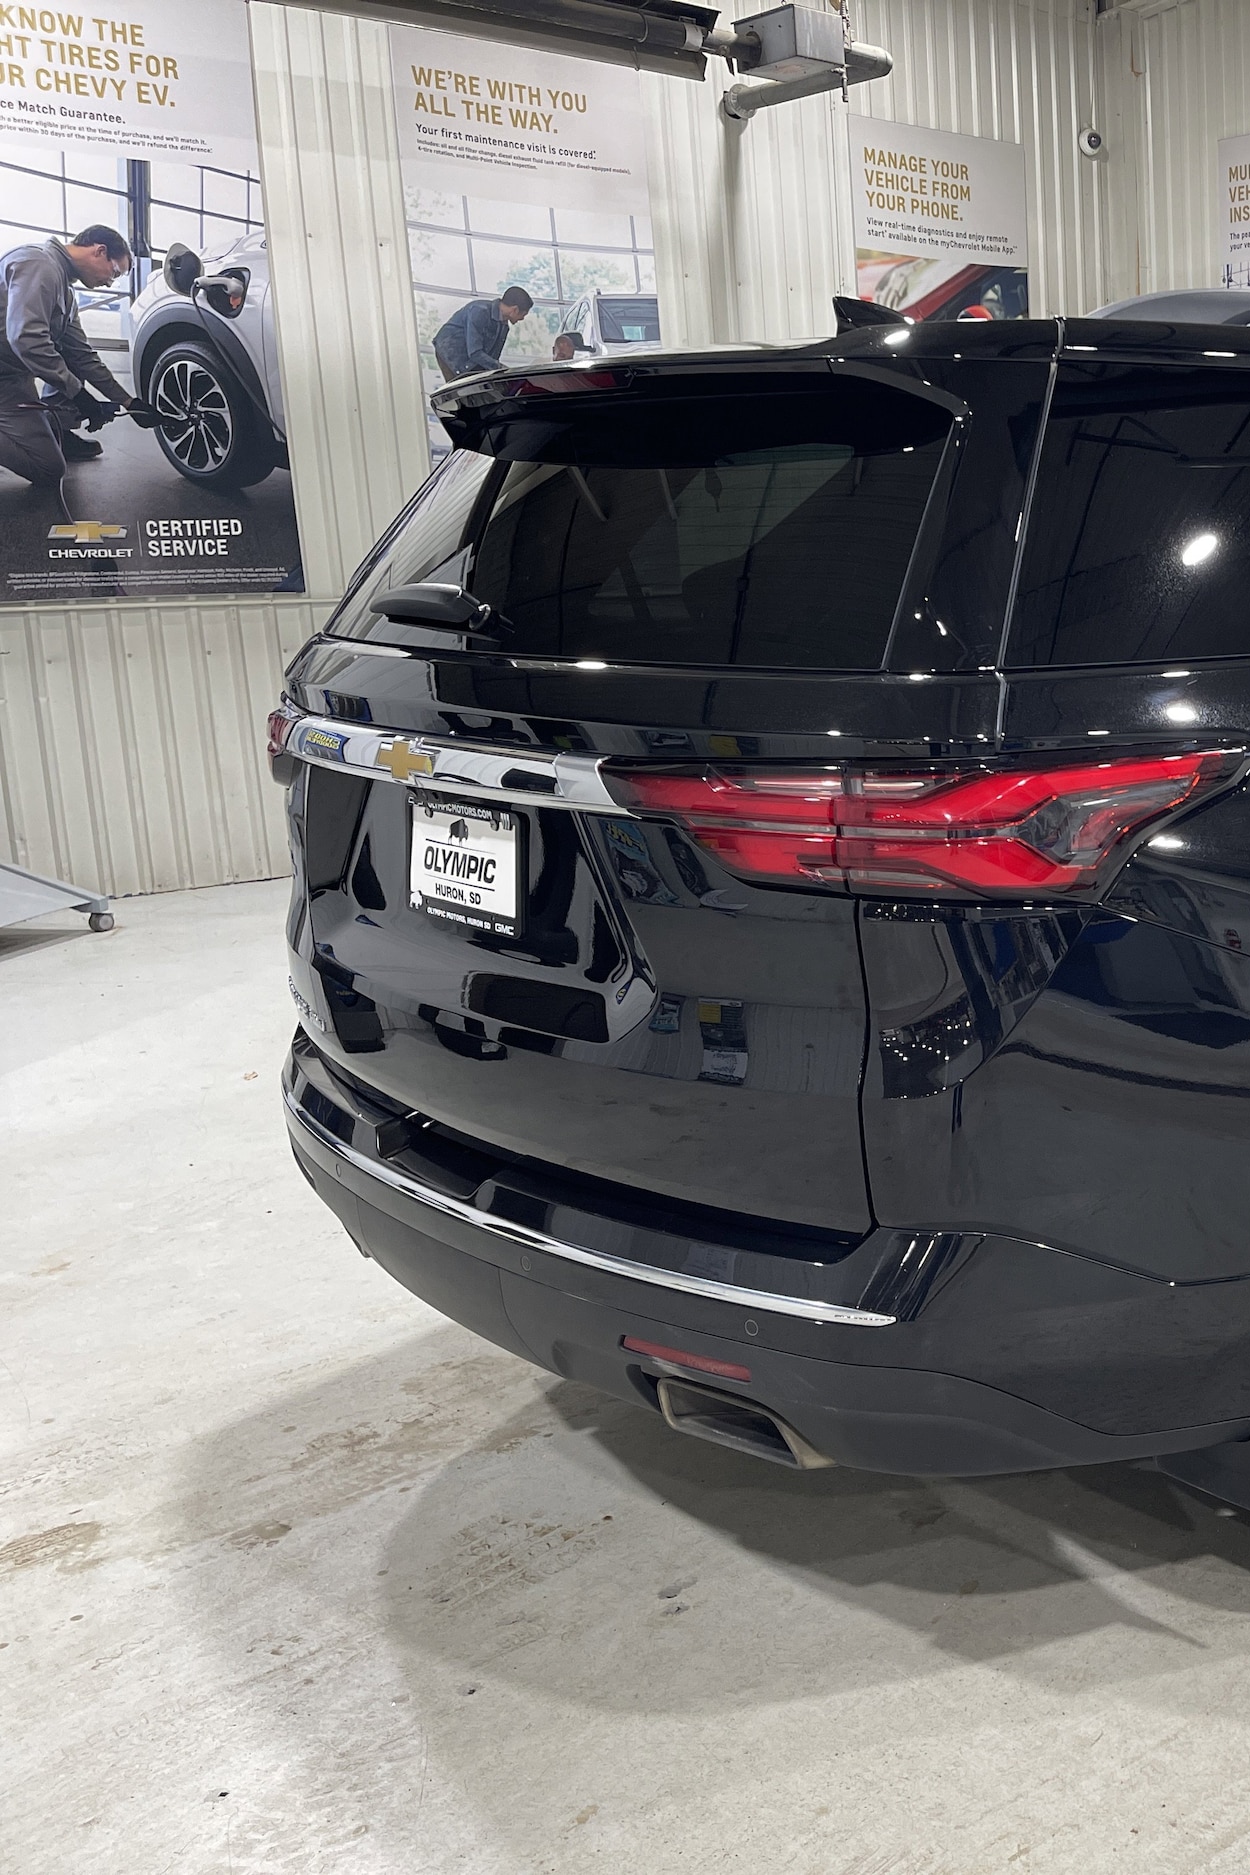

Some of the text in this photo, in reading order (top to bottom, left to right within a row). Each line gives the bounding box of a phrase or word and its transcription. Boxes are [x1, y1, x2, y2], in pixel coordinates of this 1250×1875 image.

[0, 4, 145, 47] KNOW THE
[40, 39, 120, 72] TIRES
[129, 53, 180, 80] FOR
[35, 67, 127, 101] CHEVY
[136, 82, 176, 108] EV.
[411, 64, 588, 114] WE'RE WITH YOU
[18, 100, 56, 115] Match
[60, 106, 126, 124] Guarantee.
[414, 91, 559, 134] ALL THE WAY.
[13, 117, 34, 125] better
[35, 119, 59, 129] eligible
[60, 123, 77, 132] price
[18, 126, 39, 134] within
[50, 130, 65, 138] days
[147, 141, 167, 149] refund
[415, 123, 438, 136] Your
[441, 127, 463, 141] first
[465, 134, 525, 150] maintenance
[527, 142, 547, 154] visit
[548, 144, 557, 155] is
[864, 146, 969, 181] MANAGE YOUR
[864, 168, 971, 202] VEHICLE FROM
[865, 190, 964, 222] YOUR PHONE.
[866, 217, 1009, 244] View real-time diagnostics and enjoy remote
[888, 231, 918, 243] available
[918, 237, 927, 245] on
[928, 237, 939, 246] the
[940, 240, 981, 252] myChevrolet
[982, 243, 1001, 253] Mobile
[1229, 232, 1240, 240] The
[1229, 243, 1243, 253] your
[145, 518, 243, 538] CERTIFIED
[48, 548, 133, 560] CHEVROLET
[148, 538, 229, 557] SERVICE
[424, 845, 497, 884] OLYMPIC
[435, 883, 481, 905] HURON, SD
[426, 906, 446, 918] OLYMPIC
[494, 923, 514, 936] GMC
